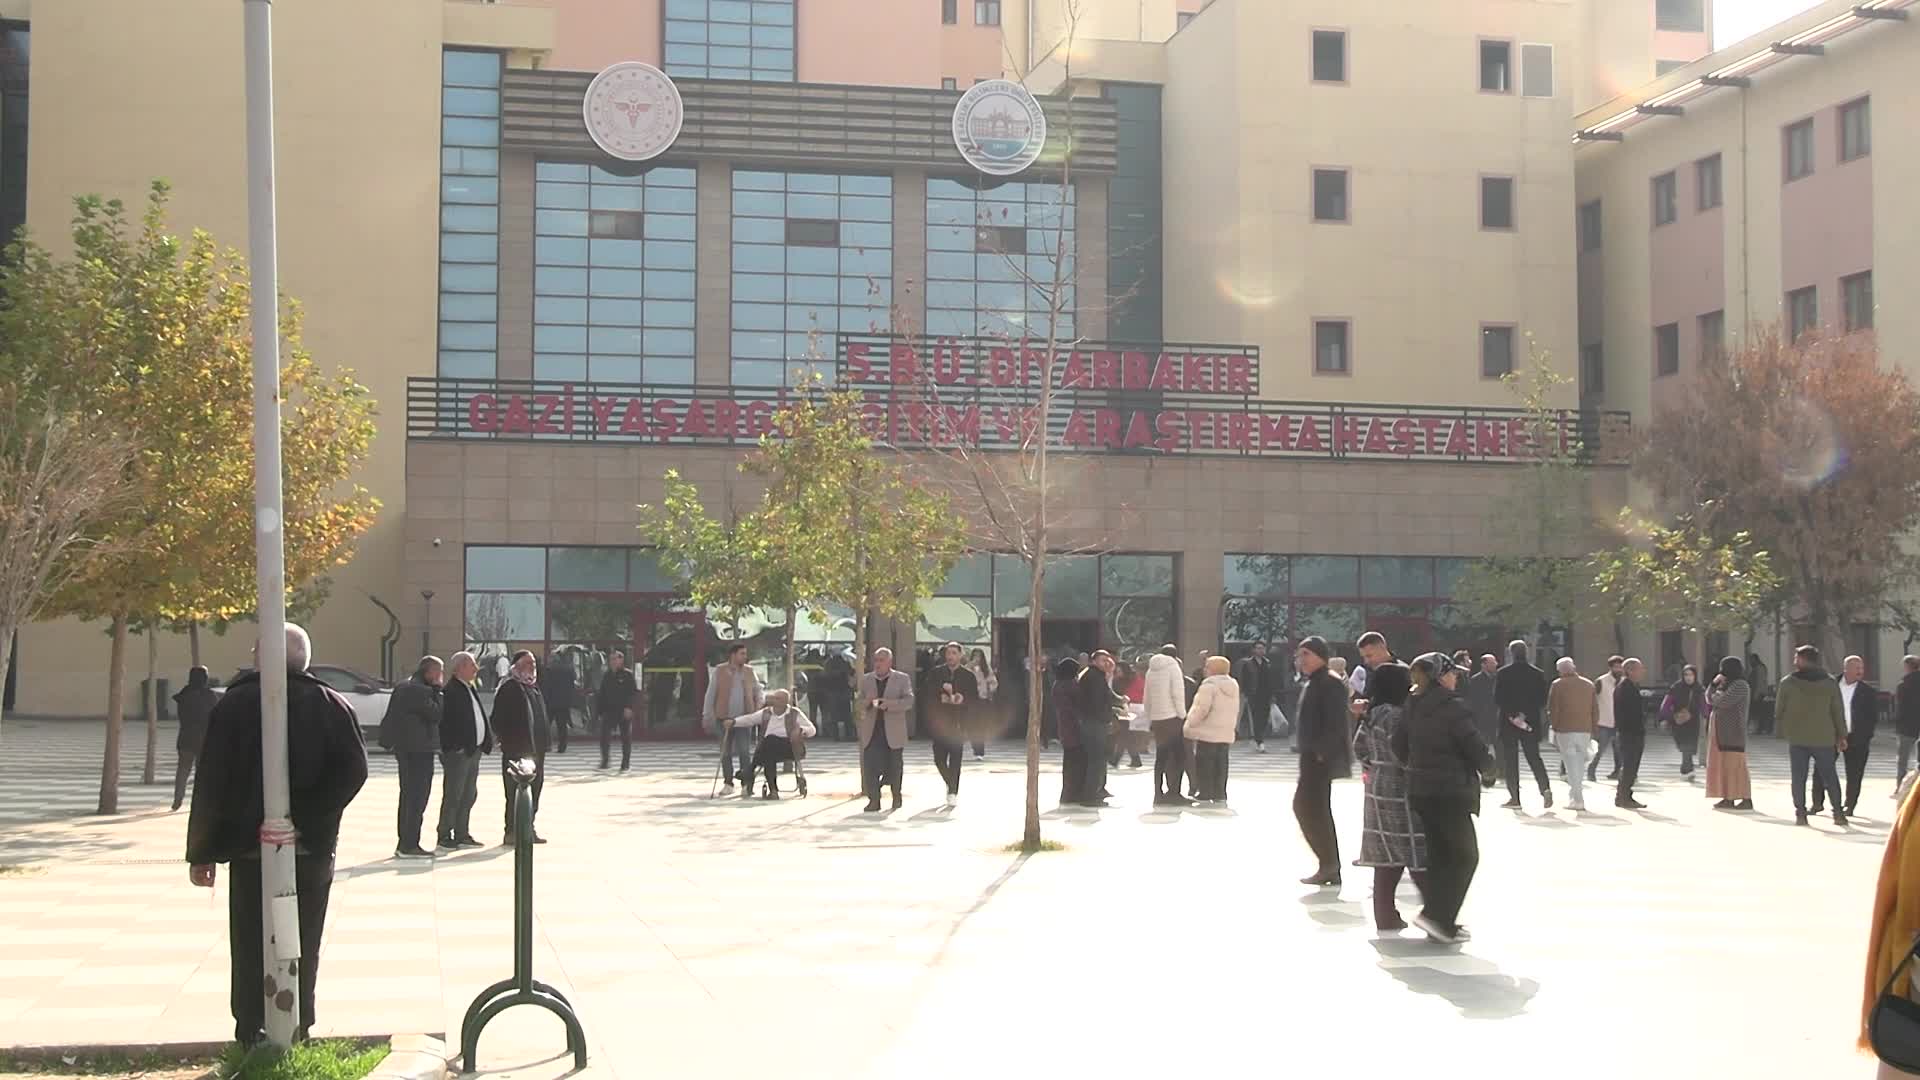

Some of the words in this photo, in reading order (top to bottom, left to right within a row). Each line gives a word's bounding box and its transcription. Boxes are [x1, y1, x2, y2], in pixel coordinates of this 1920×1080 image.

[991, 336, 1254, 393] DİYARBAKIR
[469, 384, 573, 434] GAZİ
[590, 387, 814, 443] YAŞARGİ
[828, 391, 980, 445] ĞİTİM
[1064, 407, 1321, 454] ARAŞTIRMA
[1334, 409, 1568, 456] HASTANEİ
